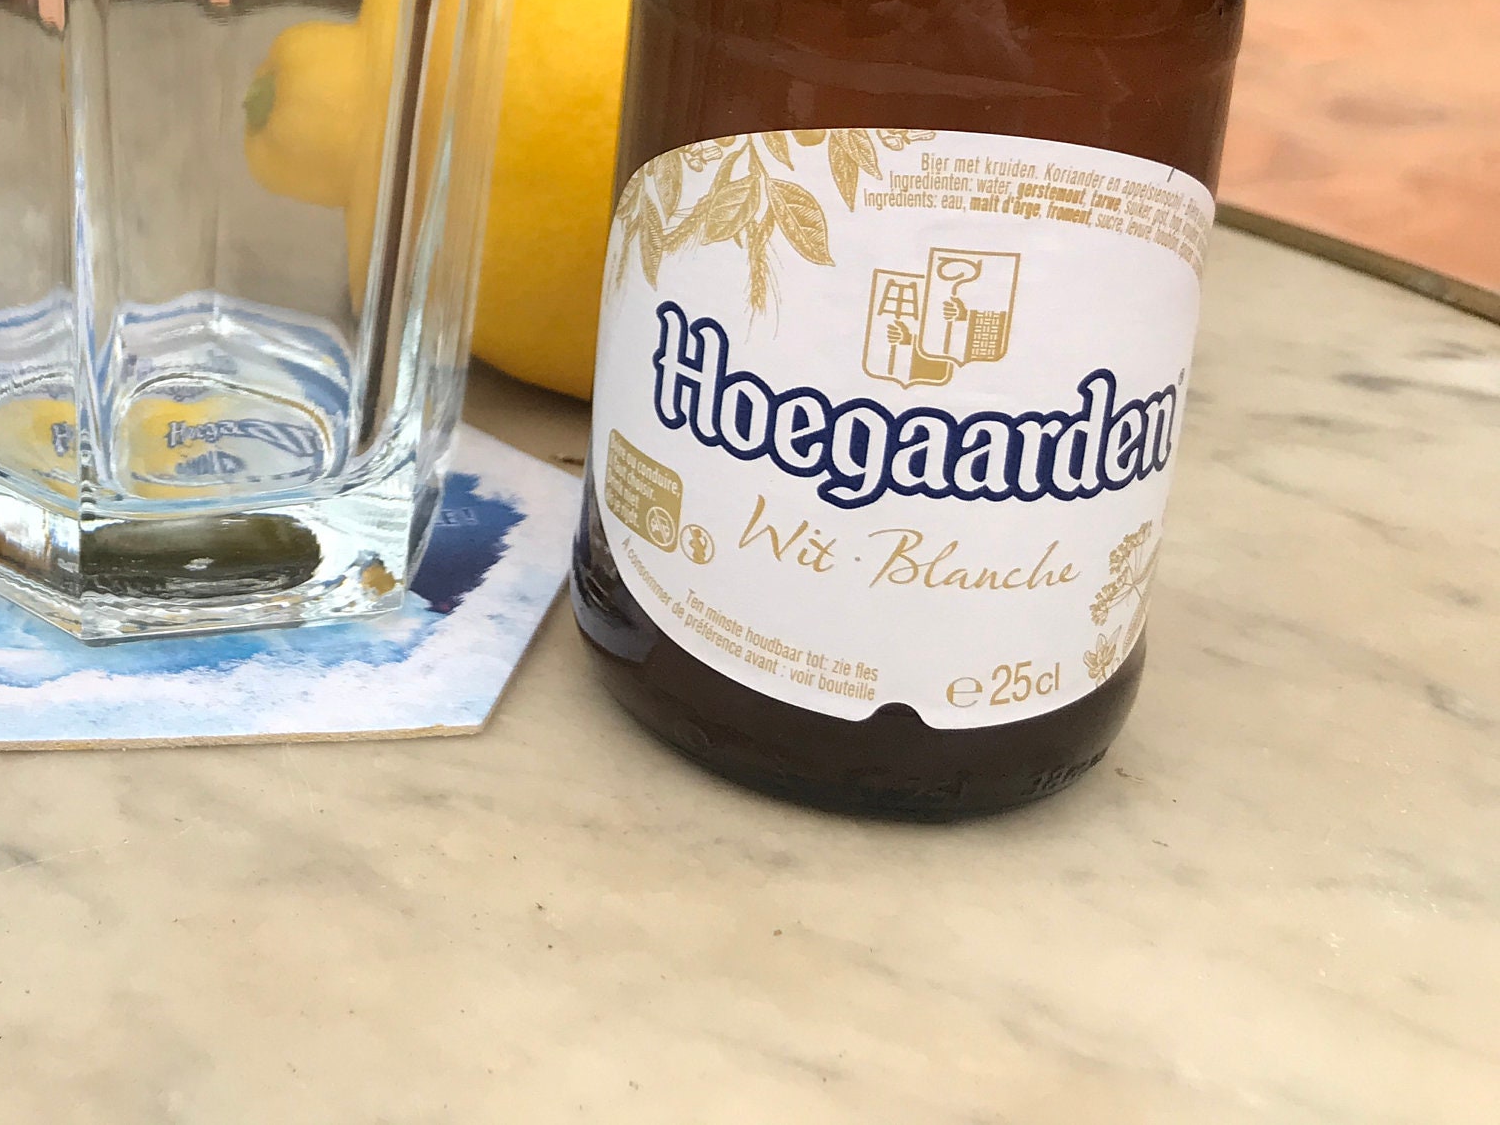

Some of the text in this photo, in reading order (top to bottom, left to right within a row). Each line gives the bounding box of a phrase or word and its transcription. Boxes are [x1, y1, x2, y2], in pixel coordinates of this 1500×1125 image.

[864, 188, 937, 210] Ingrédients:
[941, 194, 966, 213] eau,
[970, 195, 999, 213] malt
[889, 170, 973, 194] Ingrediënten:
[976, 177, 1012, 196] water,
[921, 152, 950, 172] Bier
[954, 156, 980, 174] met
[985, 156, 1038, 179] kruiden.
[1044, 162, 1106, 189] Koriander
[1106, 176, 1121, 192] en
[652, 301, 1176, 510] Hoegaarden
[738, 494, 837, 573] Wit
[868, 528, 1080, 591] Blanche
[627, 548, 672, 606] consommer
[672, 601, 685, 619] de
[684, 613, 743, 659] préférence
[744, 650, 778, 675] avant
[790, 667, 815, 687] voir
[818, 674, 875, 702] bouteille
[685, 587, 879, 682] Ten minste houdbaar tot: zie fles
[989, 661, 1060, 706] 25cl
